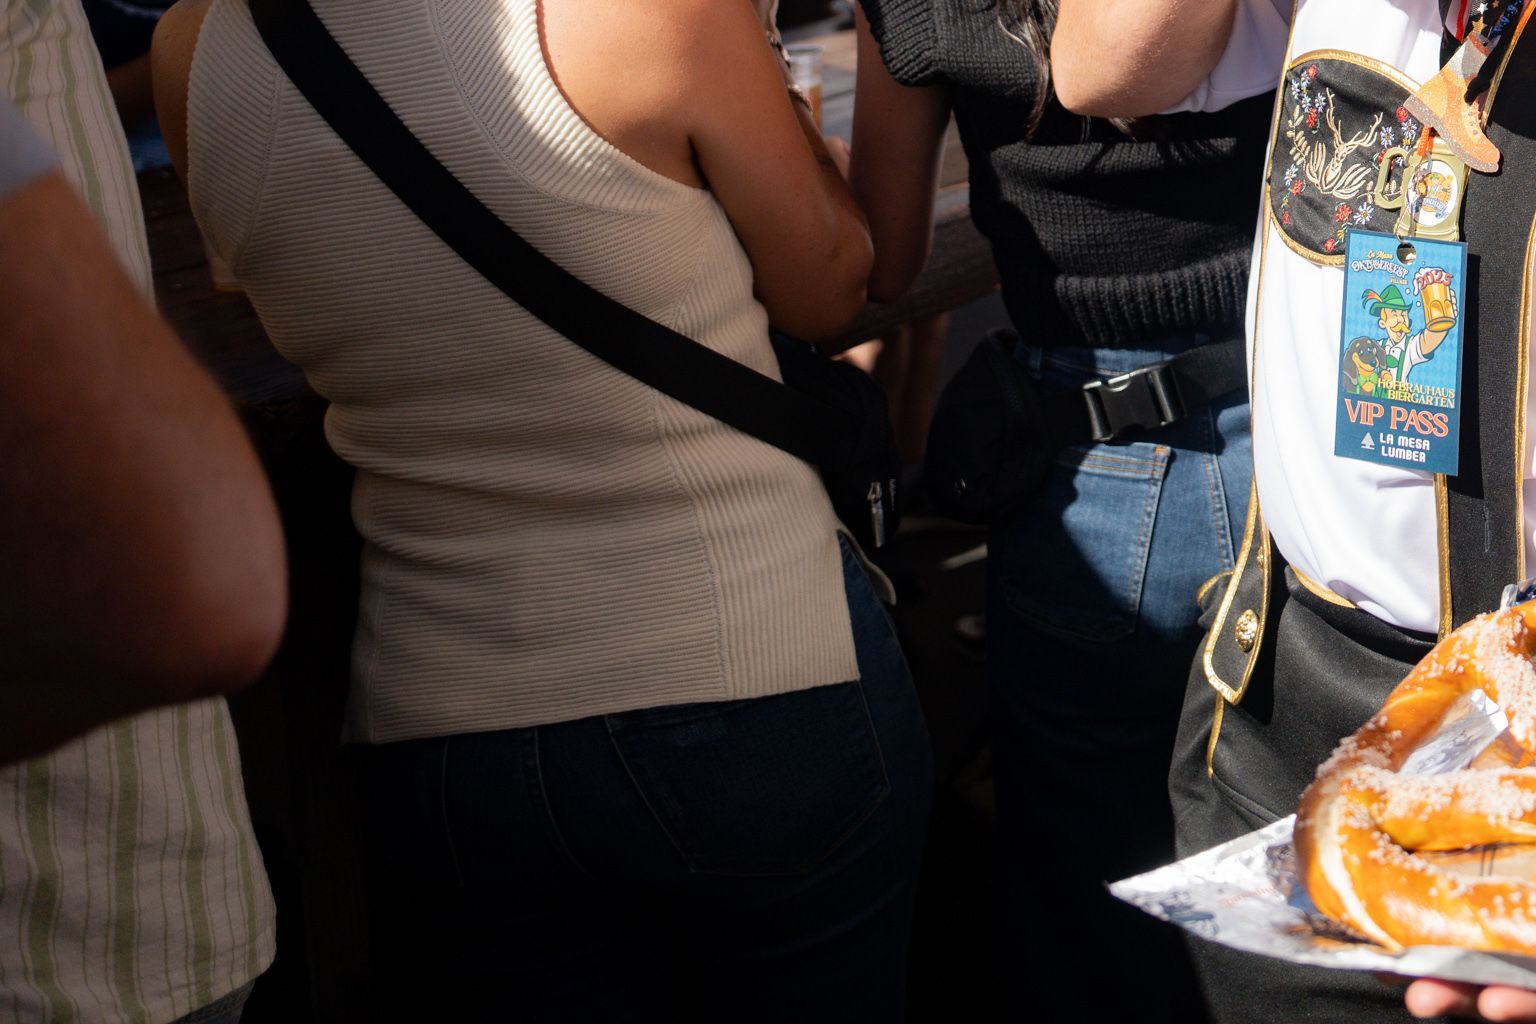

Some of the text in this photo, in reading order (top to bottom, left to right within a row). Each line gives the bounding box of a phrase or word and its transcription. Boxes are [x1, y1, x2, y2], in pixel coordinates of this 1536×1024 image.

[1351, 259, 1409, 279] OKTOBERFEST
[1388, 389, 1456, 409] BIERGARTEN
[1344, 398, 1449, 438] VIP PASS
[1379, 432, 1431, 451] LA MESA
[1381, 445, 1427, 463] LUMBER
